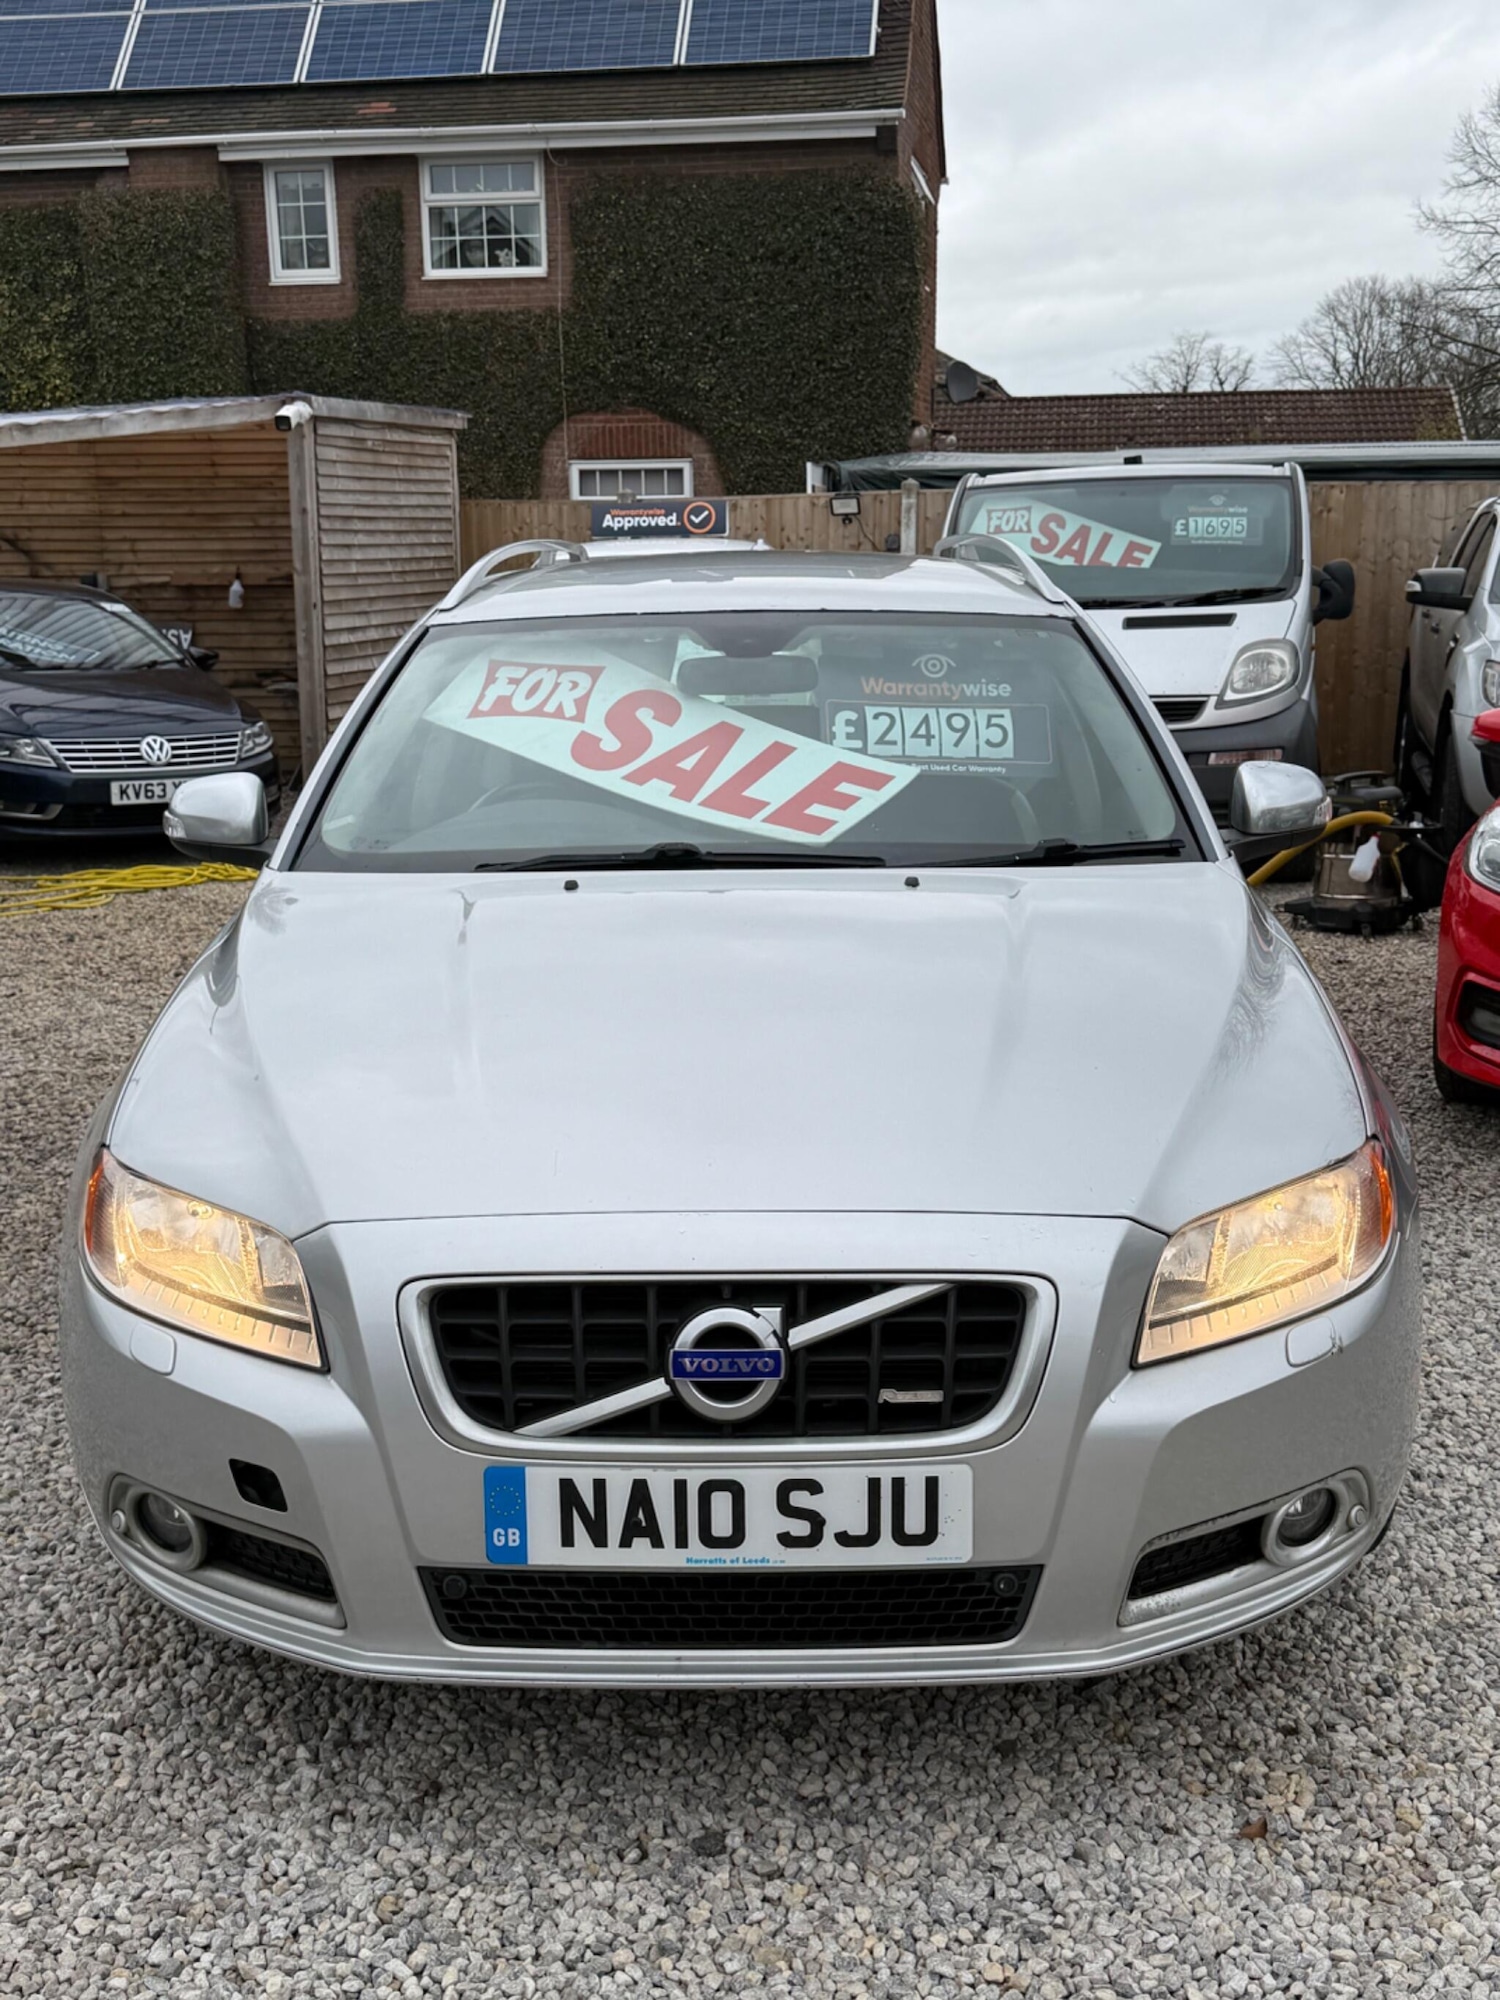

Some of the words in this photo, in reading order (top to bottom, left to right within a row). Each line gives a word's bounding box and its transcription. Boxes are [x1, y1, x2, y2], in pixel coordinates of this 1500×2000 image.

[988, 509, 1029, 534] FOR
[1030, 513, 1154, 567] SALE
[1174, 518, 1246, 536] £1695
[861, 676, 1012, 700] Warrantywise
[831, 709, 1010, 749] £2495
[482, 665, 593, 719] FOR
[570, 689, 897, 837] SALE
[119, 782, 167, 801] KV63
[678, 1357, 776, 1373] VOLVO
[558, 1477, 746, 1550] NA10
[775, 1475, 940, 1549] SJU
[492, 1527, 521, 1547] GB
